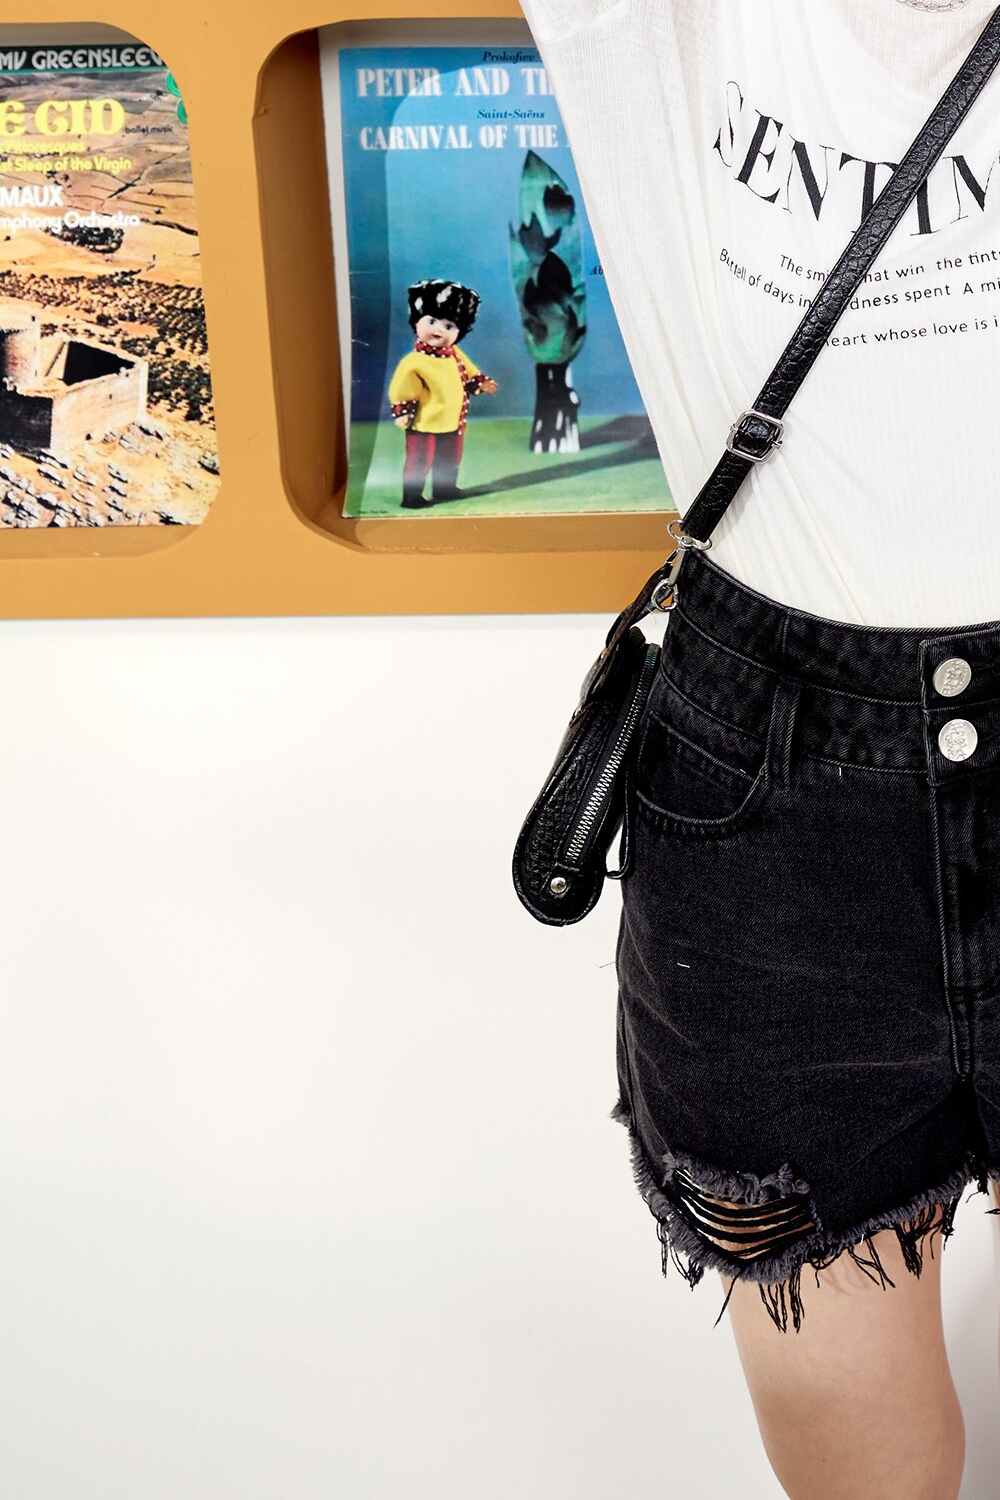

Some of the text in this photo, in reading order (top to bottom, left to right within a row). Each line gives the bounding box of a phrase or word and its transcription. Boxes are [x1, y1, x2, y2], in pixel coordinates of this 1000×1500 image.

[482, 51, 536, 65] Prokofiev
[356, 68, 443, 98] PETER
[455, 68, 510, 97] AND
[34, 97, 126, 136] CID
[477, 108, 545, 120] Saint-Saëns
[359, 125, 473, 151] CARNIVAL
[479, 125, 508, 149] OF
[515, 124, 559, 149] THE
[14, 155, 132, 175] Sleep of the Virgin
[64, 210, 141, 229] Orchestra
[780, 254, 803, 276] The
[895, 264, 925, 279] win
[936, 256, 963, 271] the
[748, 274, 762, 287] of
[763, 280, 795, 304] days
[845, 291, 899, 311] dness
[904, 284, 951, 303] spent
[963, 283, 974, 296] A
[874, 324, 929, 343] whose
[933, 322, 968, 336] love
[975, 317, 988, 331] is
